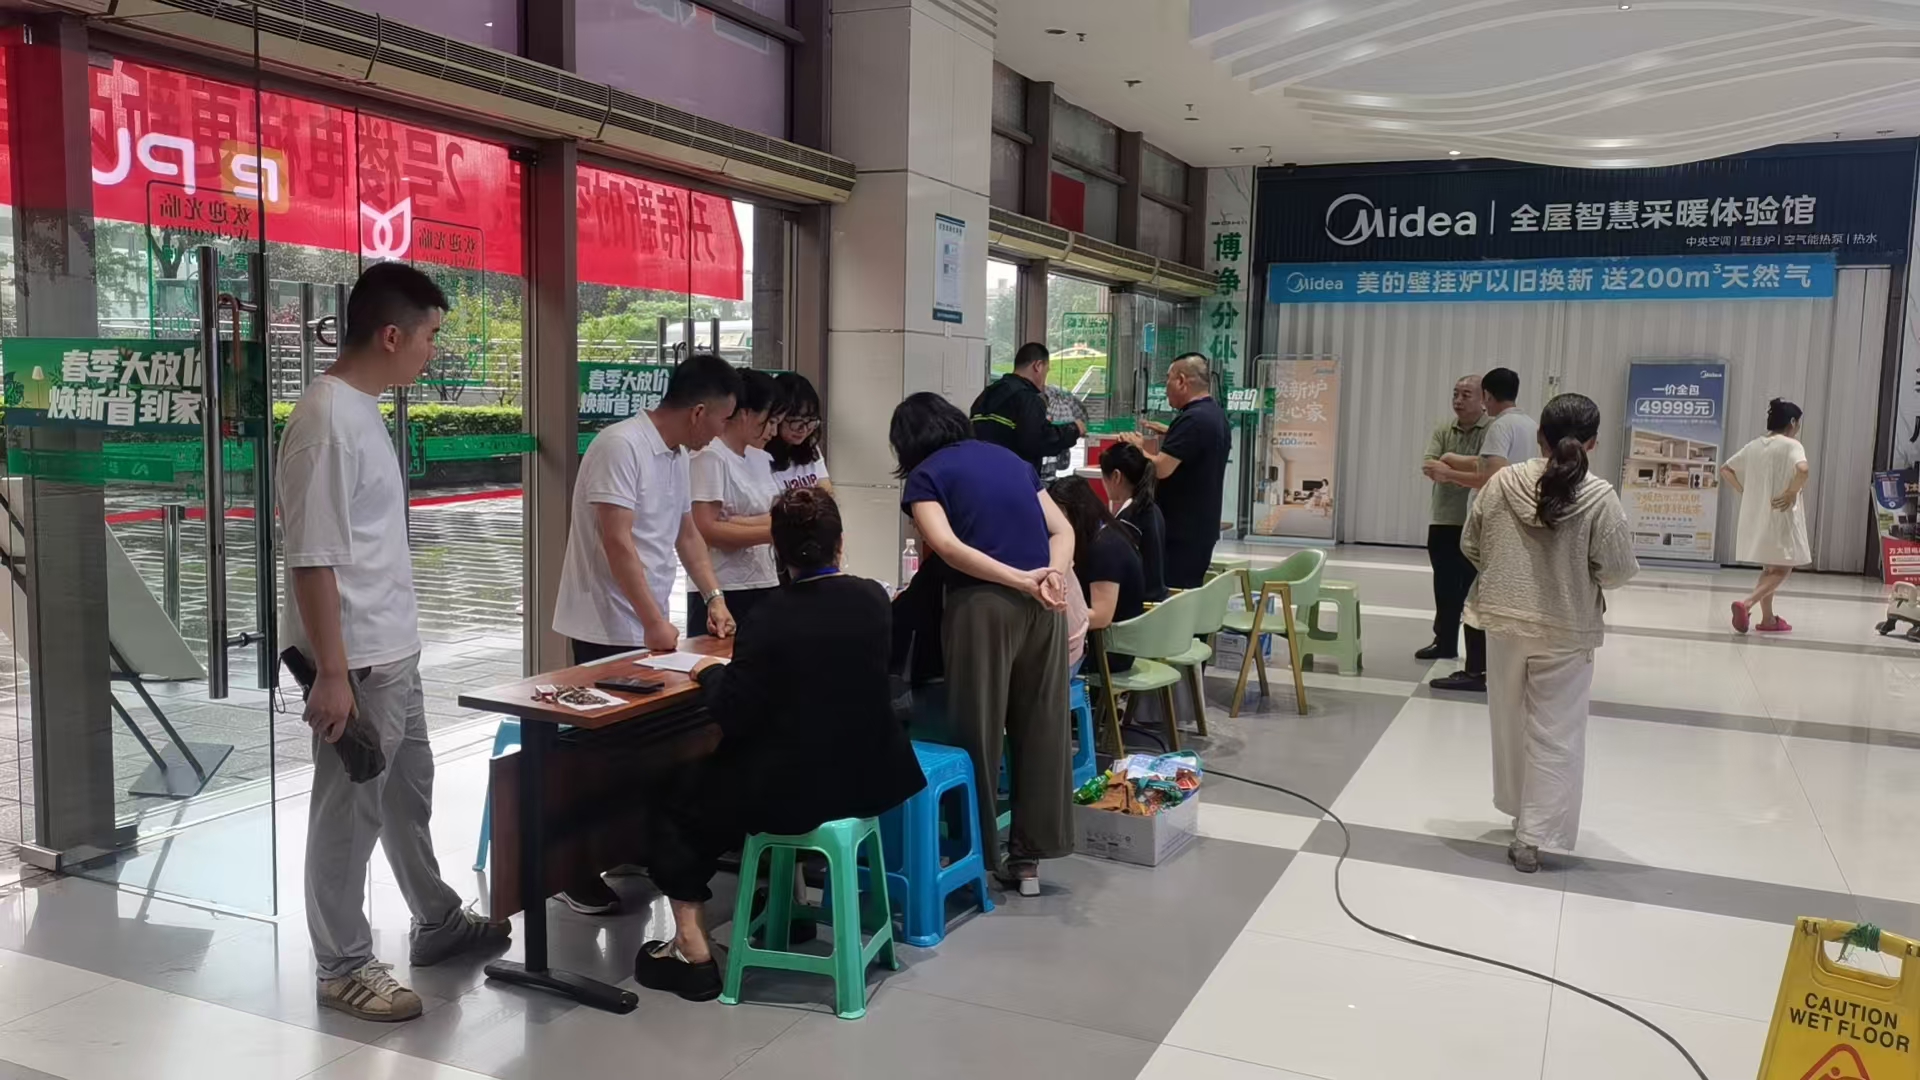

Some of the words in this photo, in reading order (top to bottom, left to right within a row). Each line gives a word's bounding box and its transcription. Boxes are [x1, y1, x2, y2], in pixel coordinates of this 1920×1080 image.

[1325, 193, 1477, 246] Midea
[1511, 195, 1816, 232] 全屋智慧采暖体验馆
[1686, 235, 1731, 247] 中央空调
[1740, 235, 1775, 247] 壁挂炉
[1784, 233, 1843, 245] 空气能热泵
[1853, 232, 1877, 244] 热水
[1287, 271, 1343, 293] Midea
[1357, 268, 1593, 294] 美的壁挂炉以旧换新
[588, 368, 670, 399] 春季大放价
[1652, 384, 1699, 396] 一价全包
[1639, 400, 1710, 415] 49999元
[1805, 992, 1898, 1030] CAUTION
[1790, 1007, 1833, 1032] WET
[1838, 1019, 1910, 1053] FLOOR
